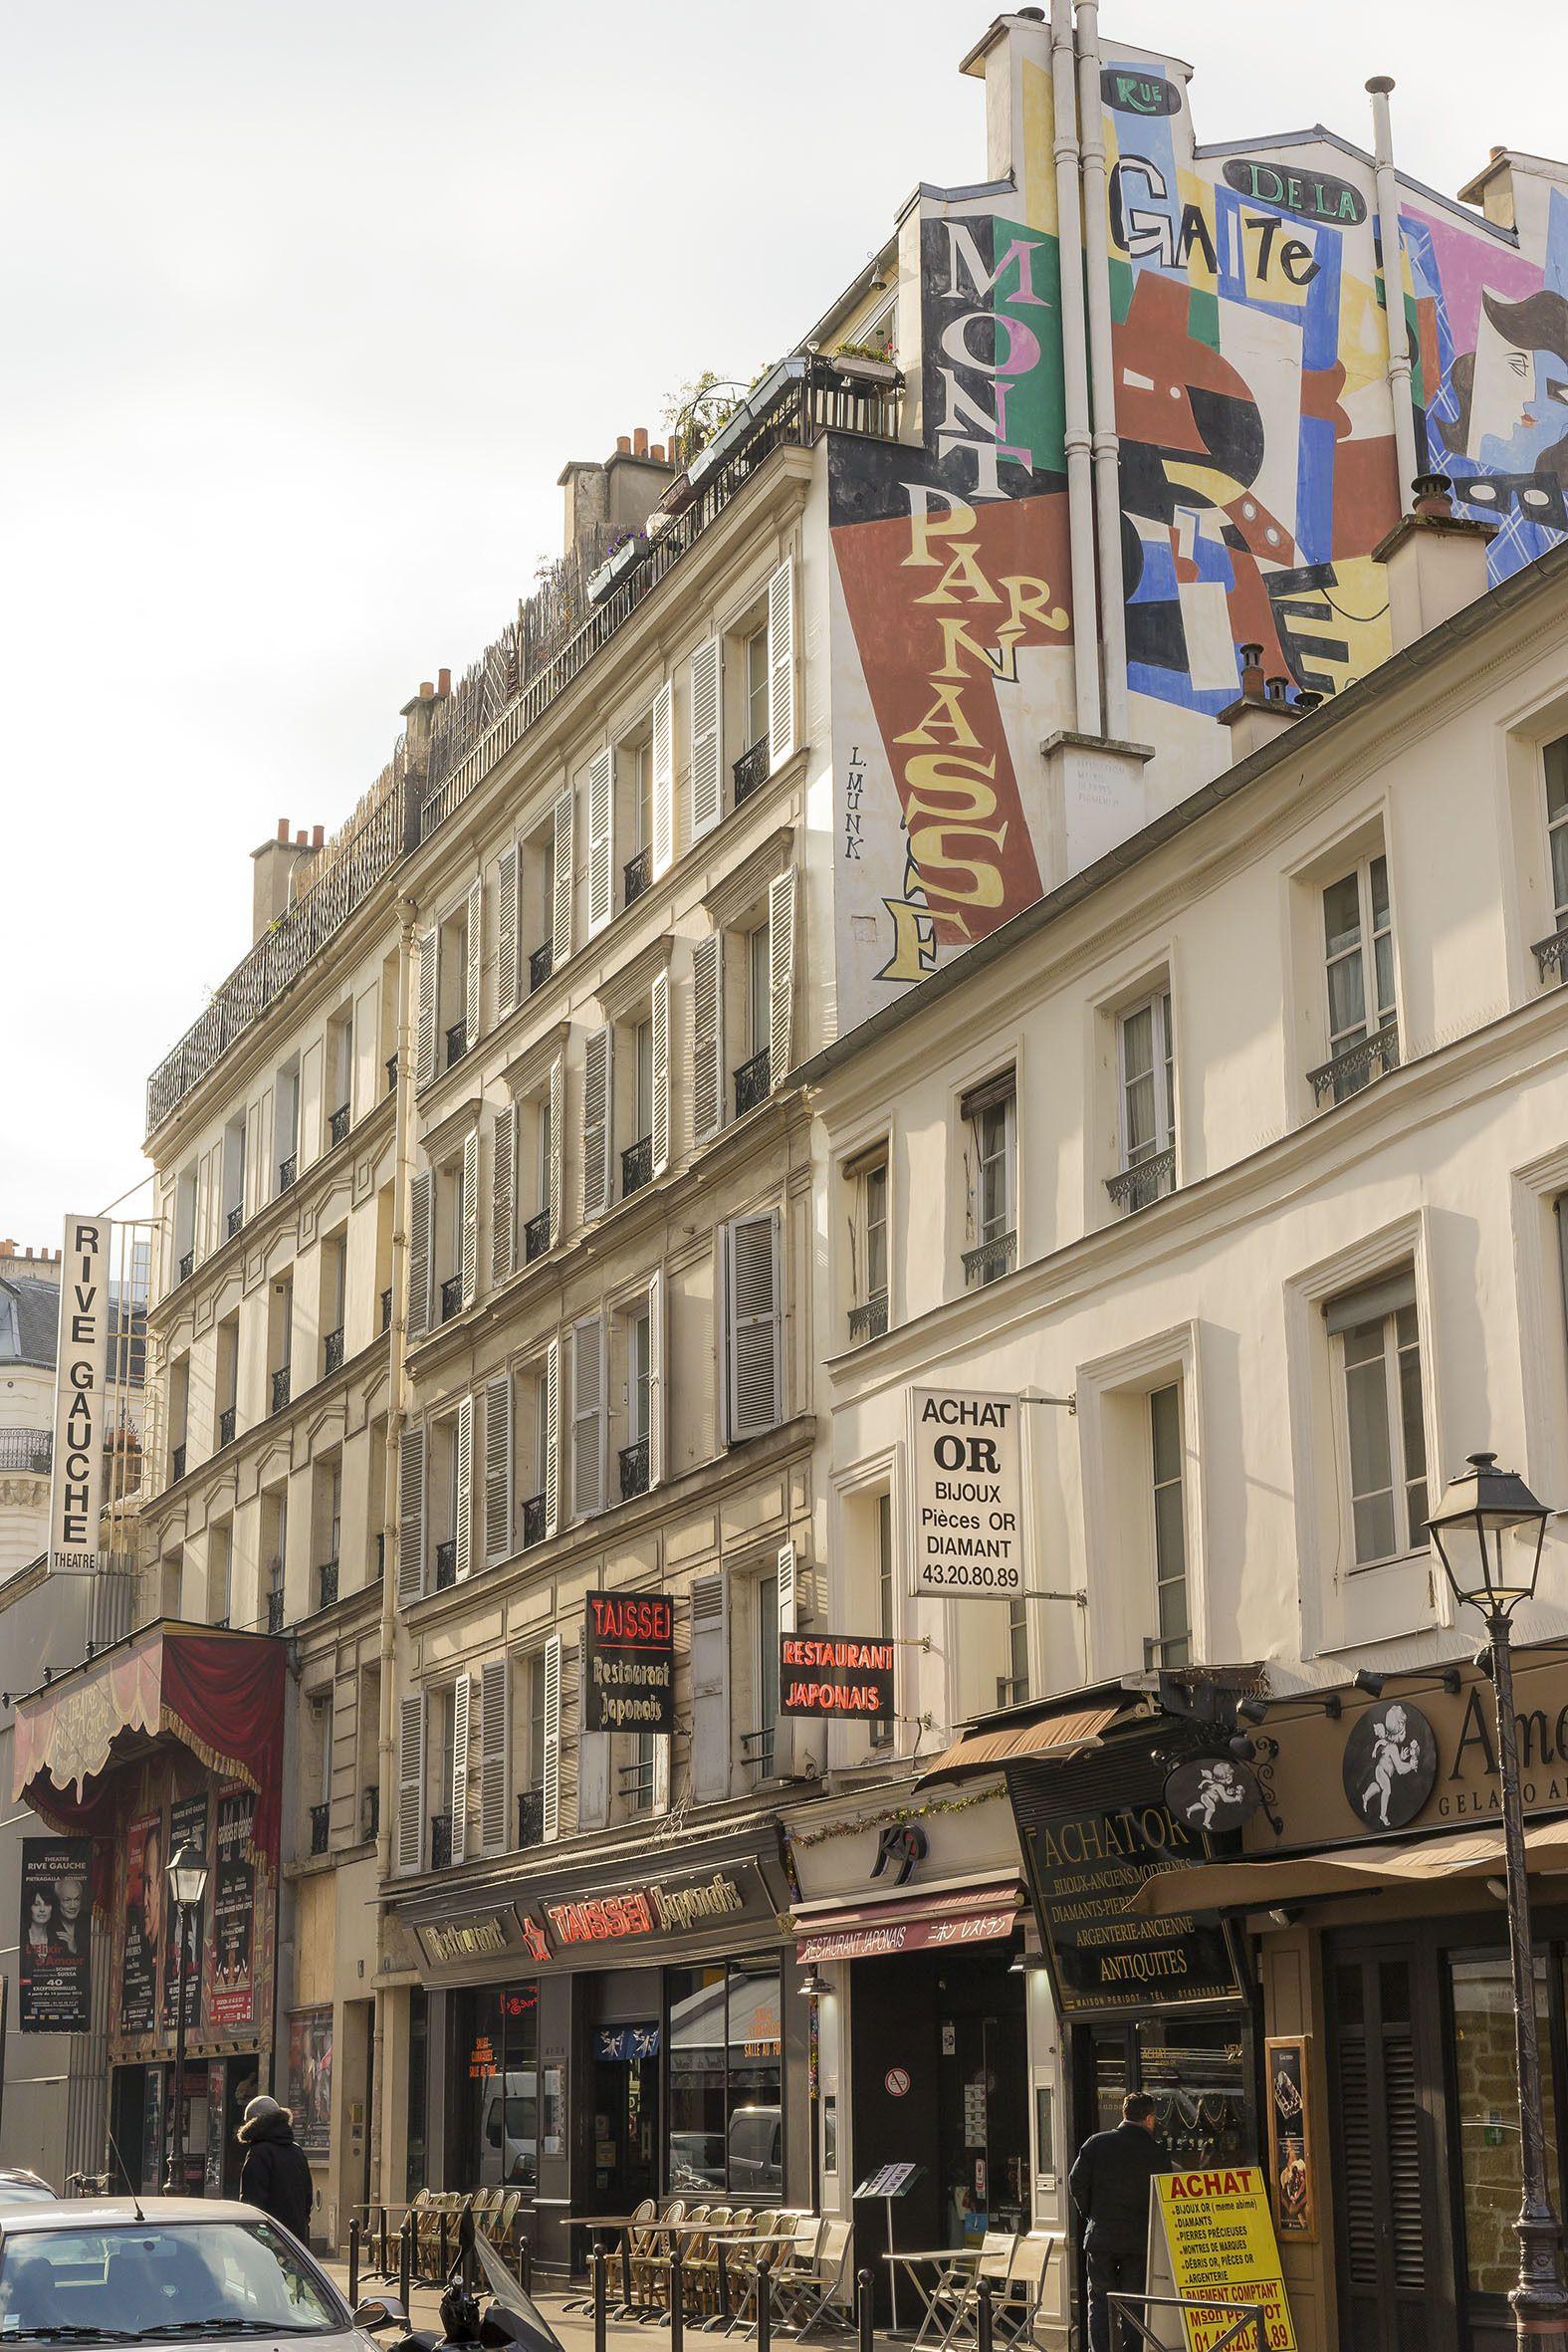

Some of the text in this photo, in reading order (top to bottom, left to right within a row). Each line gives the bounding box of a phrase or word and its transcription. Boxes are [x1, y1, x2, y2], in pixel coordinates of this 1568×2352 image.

[1249, 164, 1357, 221] DE LA
[845, 771, 864, 859] MUNK
[63, 1226, 100, 1544] RIVE GAUCHE
[922, 1398, 1010, 1427] ACHAT
[934, 1435, 1001, 1474] OR
[935, 1482, 1002, 1503] BIJOUX
[922, 1508, 1015, 1530] Pièces OR
[54, 1551, 96, 1569] THEATRE
[927, 1536, 1011, 1557] DIAMANT
[923, 1564, 1019, 1587] 43.20.80.89
[592, 1599, 671, 1639] TAISSEI
[784, 1641, 894, 1670] RESTAURANT
[593, 1656, 670, 1687] Restaurant
[785, 1682, 880, 1710] JAPONAIS
[1439, 1777, 1568, 1816] GELAO A
[549, 1892, 654, 1944] TAISSEI
[805, 1926, 907, 1960] RESTAURANT JAPONAIS
[1101, 1949, 1188, 1982] ANTIQUITES
[1076, 1997, 1104, 2007] MAISON
[1171, 2171, 1251, 2199] ACHAT
[1176, 2205, 1200, 2215] BIJOUX
[1201, 2203, 1211, 2213] OR
[1177, 2216, 1213, 2229] DIAMANTS
[1180, 2226, 1247, 2240] PIERRES PRÉCIEUSES
[1183, 2239, 1247, 2254] MONTRES DE MARQUES
[1244, 2254, 1254, 2263] OR
[1189, 2270, 1229, 2283] ARGENTERIE
[1232, 2282, 1278, 2301] COMPTANT
